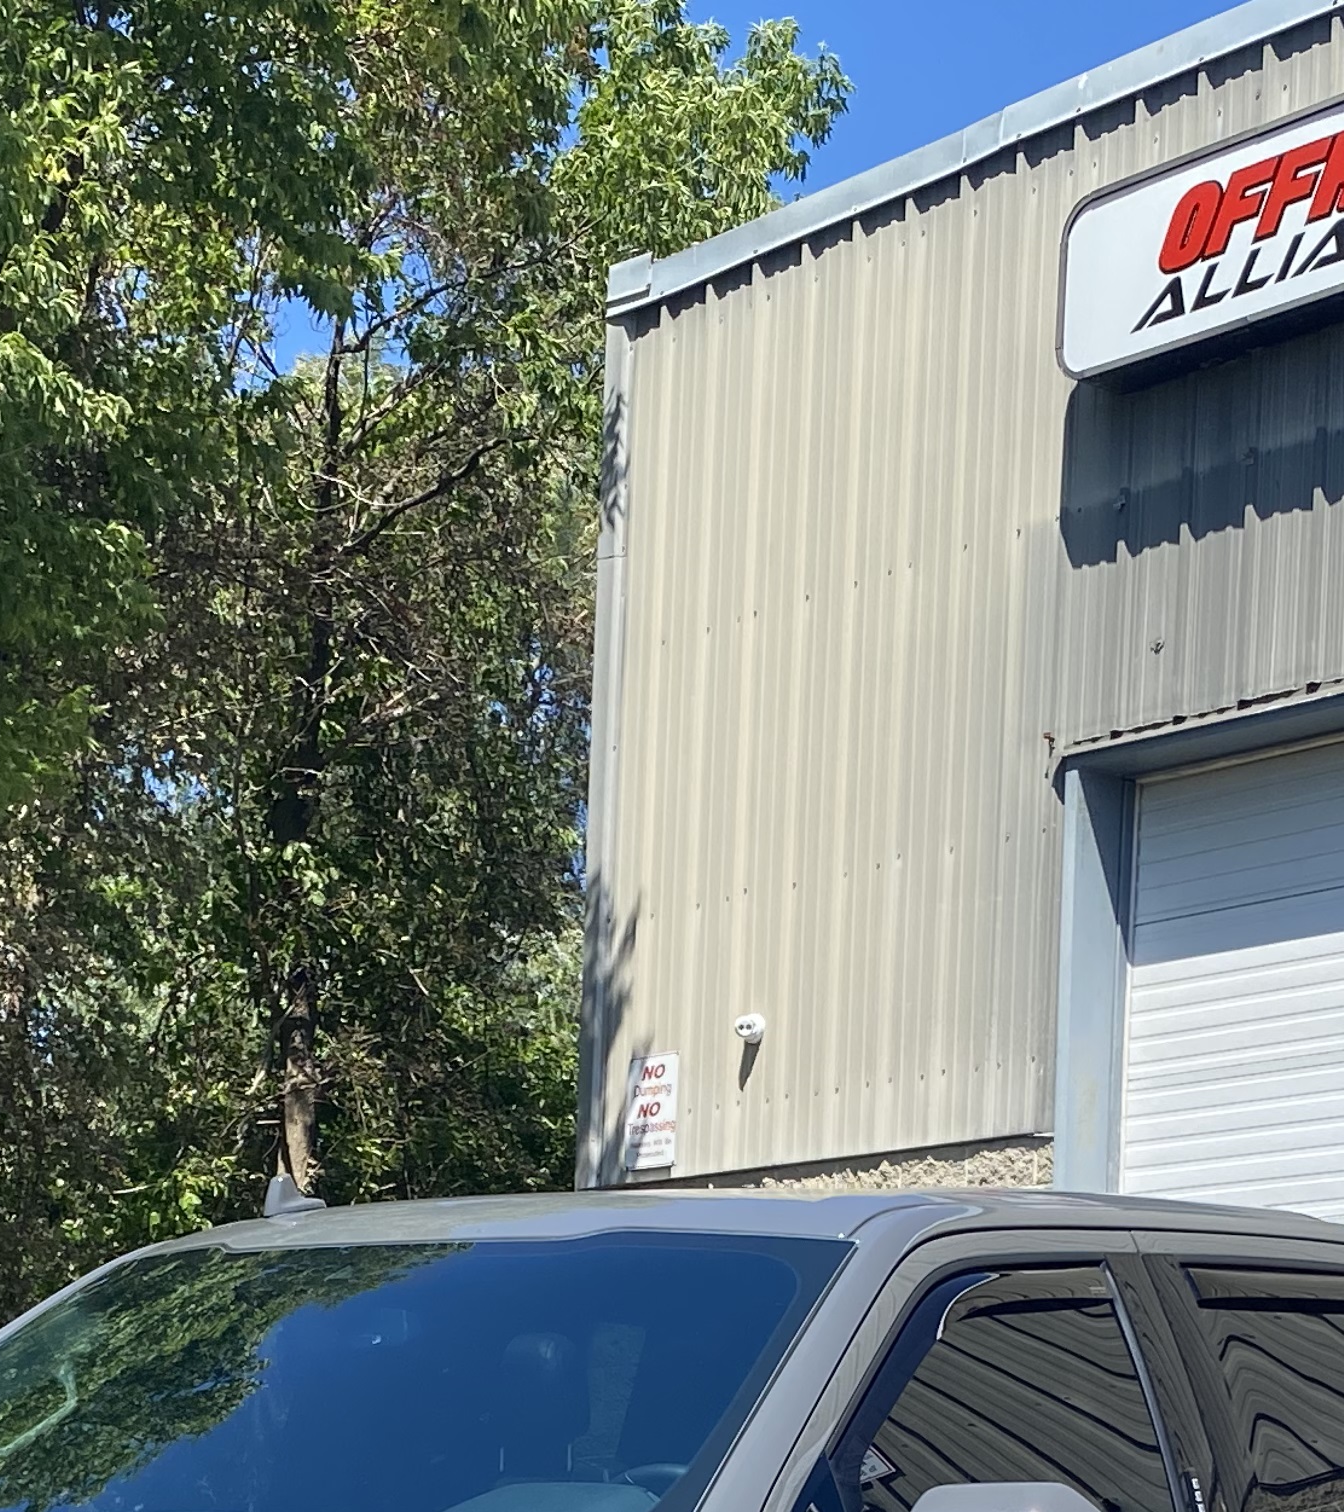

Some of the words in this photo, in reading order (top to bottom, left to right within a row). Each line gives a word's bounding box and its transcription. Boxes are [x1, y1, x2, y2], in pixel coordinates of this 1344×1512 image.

[642, 1063, 666, 1081] NO
[633, 1083, 672, 1098] Dumping
[637, 1101, 661, 1119] NO
[628, 1121, 676, 1136] Trespassing
